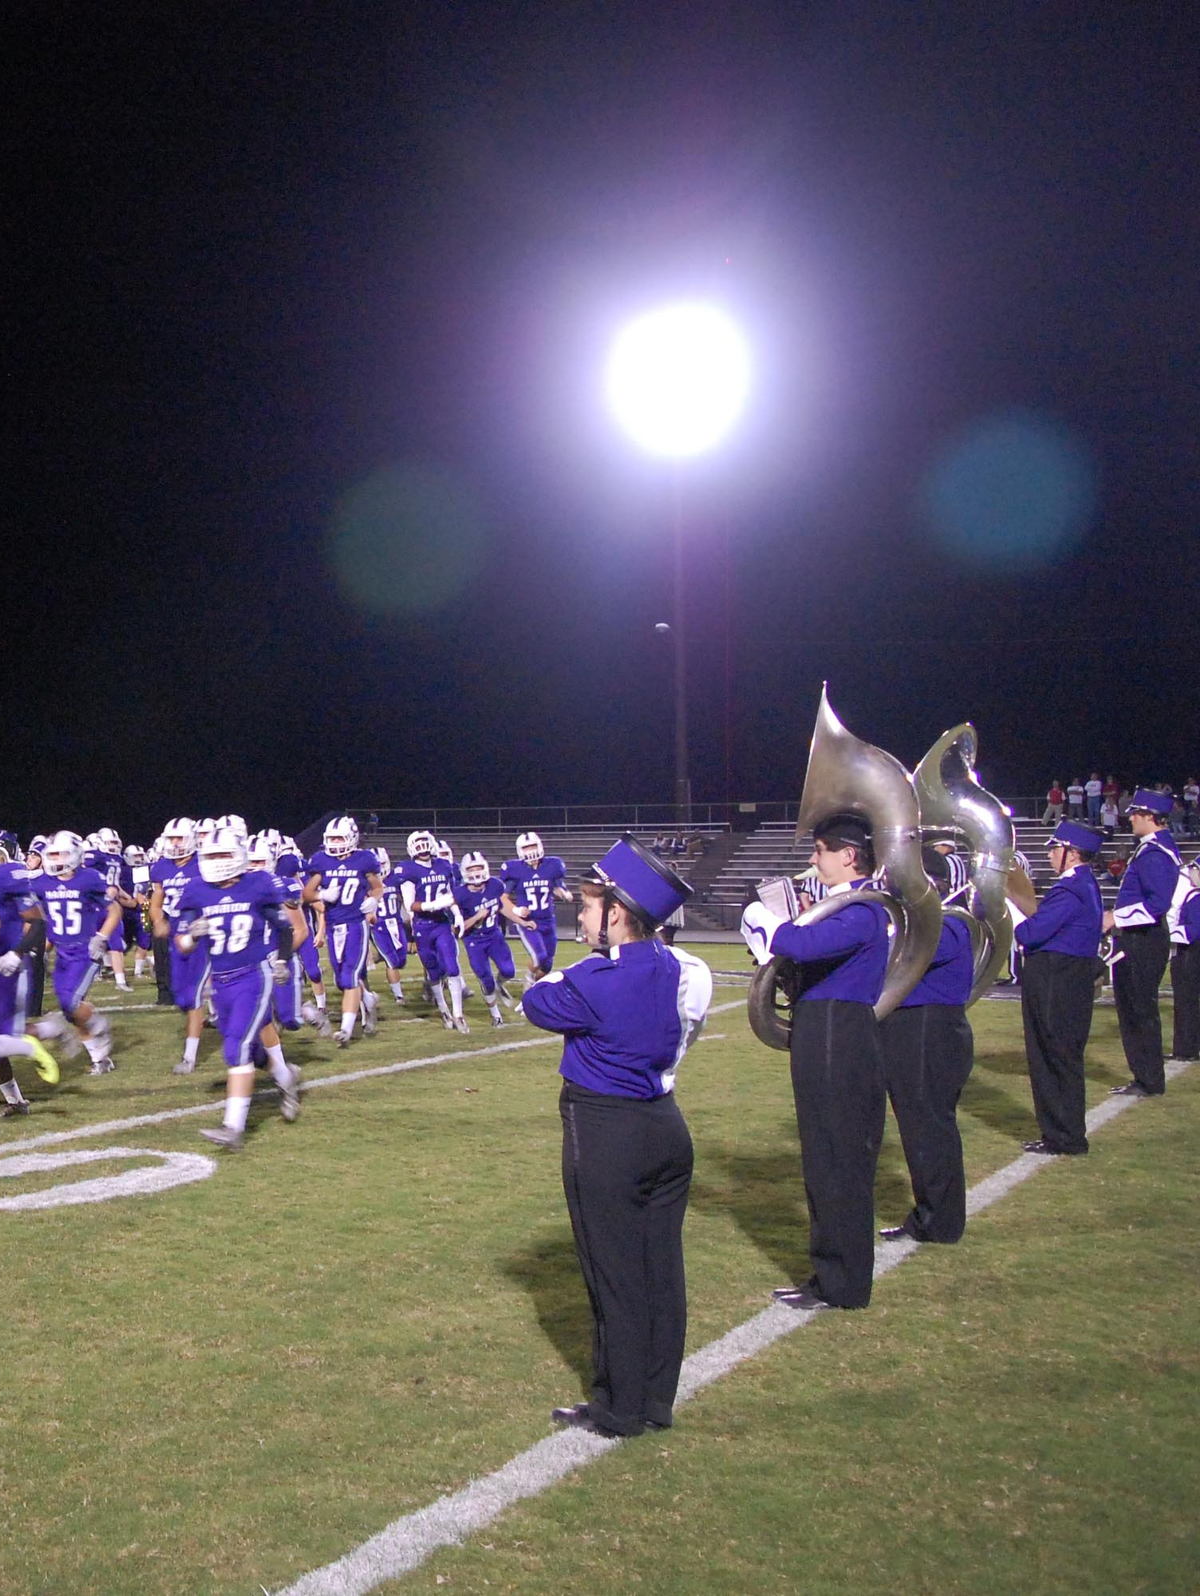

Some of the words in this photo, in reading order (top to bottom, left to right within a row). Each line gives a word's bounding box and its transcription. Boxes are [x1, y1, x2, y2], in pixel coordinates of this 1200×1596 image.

[325, 869, 358, 877] MARION
[421, 874, 446, 885] MARION
[523, 879, 549, 888] MARION
[45, 889, 80, 900] MARION
[525, 886, 550, 911] 52
[202, 901, 251, 918] MARION
[47, 900, 83, 936] 55
[207, 914, 254, 956] 58
